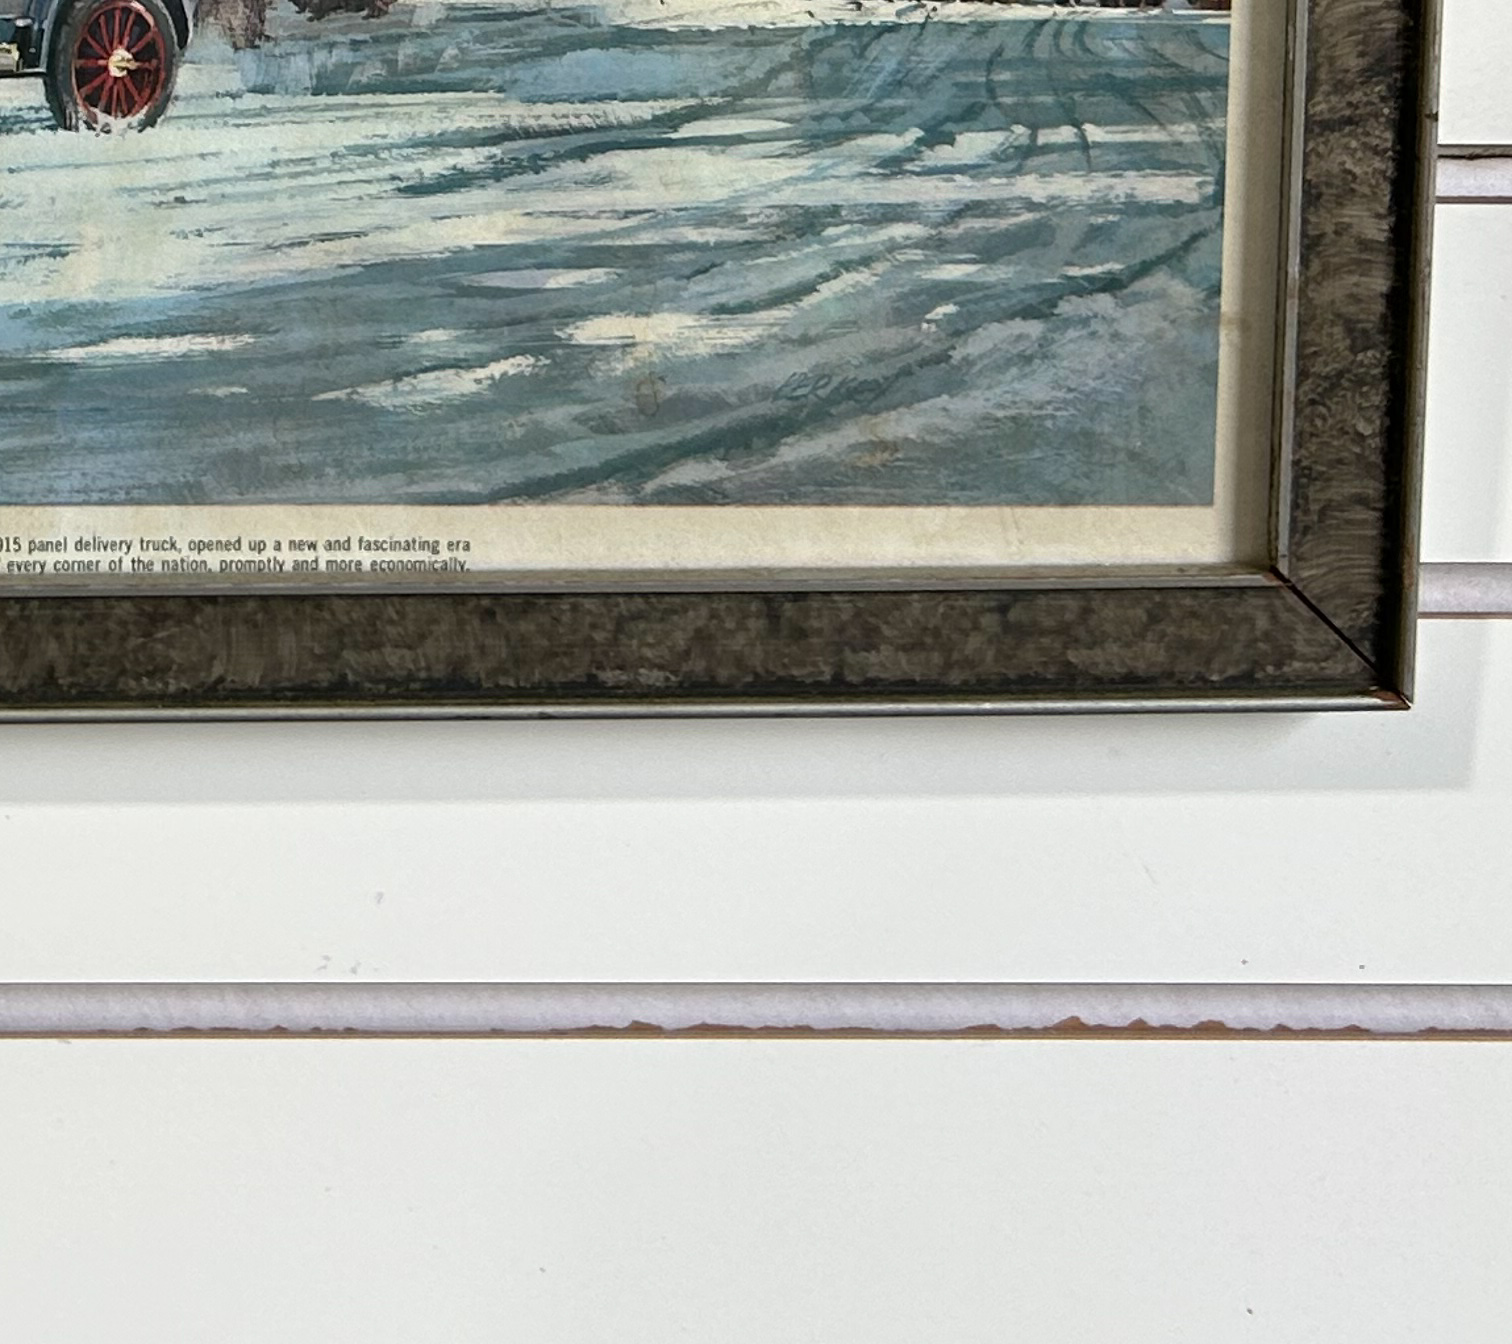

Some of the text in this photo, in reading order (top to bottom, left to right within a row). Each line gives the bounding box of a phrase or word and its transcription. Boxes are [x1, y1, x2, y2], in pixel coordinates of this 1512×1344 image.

[28, 537, 68, 556] panel
[74, 537, 132, 556] delivery
[188, 537, 242, 556] opened
[248, 540, 267, 555] up
[273, 540, 282, 552] a
[289, 540, 317, 552] new
[324, 536, 351, 552] and
[357, 536, 440, 555] fascinating
[447, 540, 471, 552] era
[6, 560, 46, 574] every
[108, 557, 123, 573] of
[131, 557, 154, 572] the
[219, 557, 285, 572] promptly
[291, 557, 319, 572] and
[325, 559, 362, 572] more
